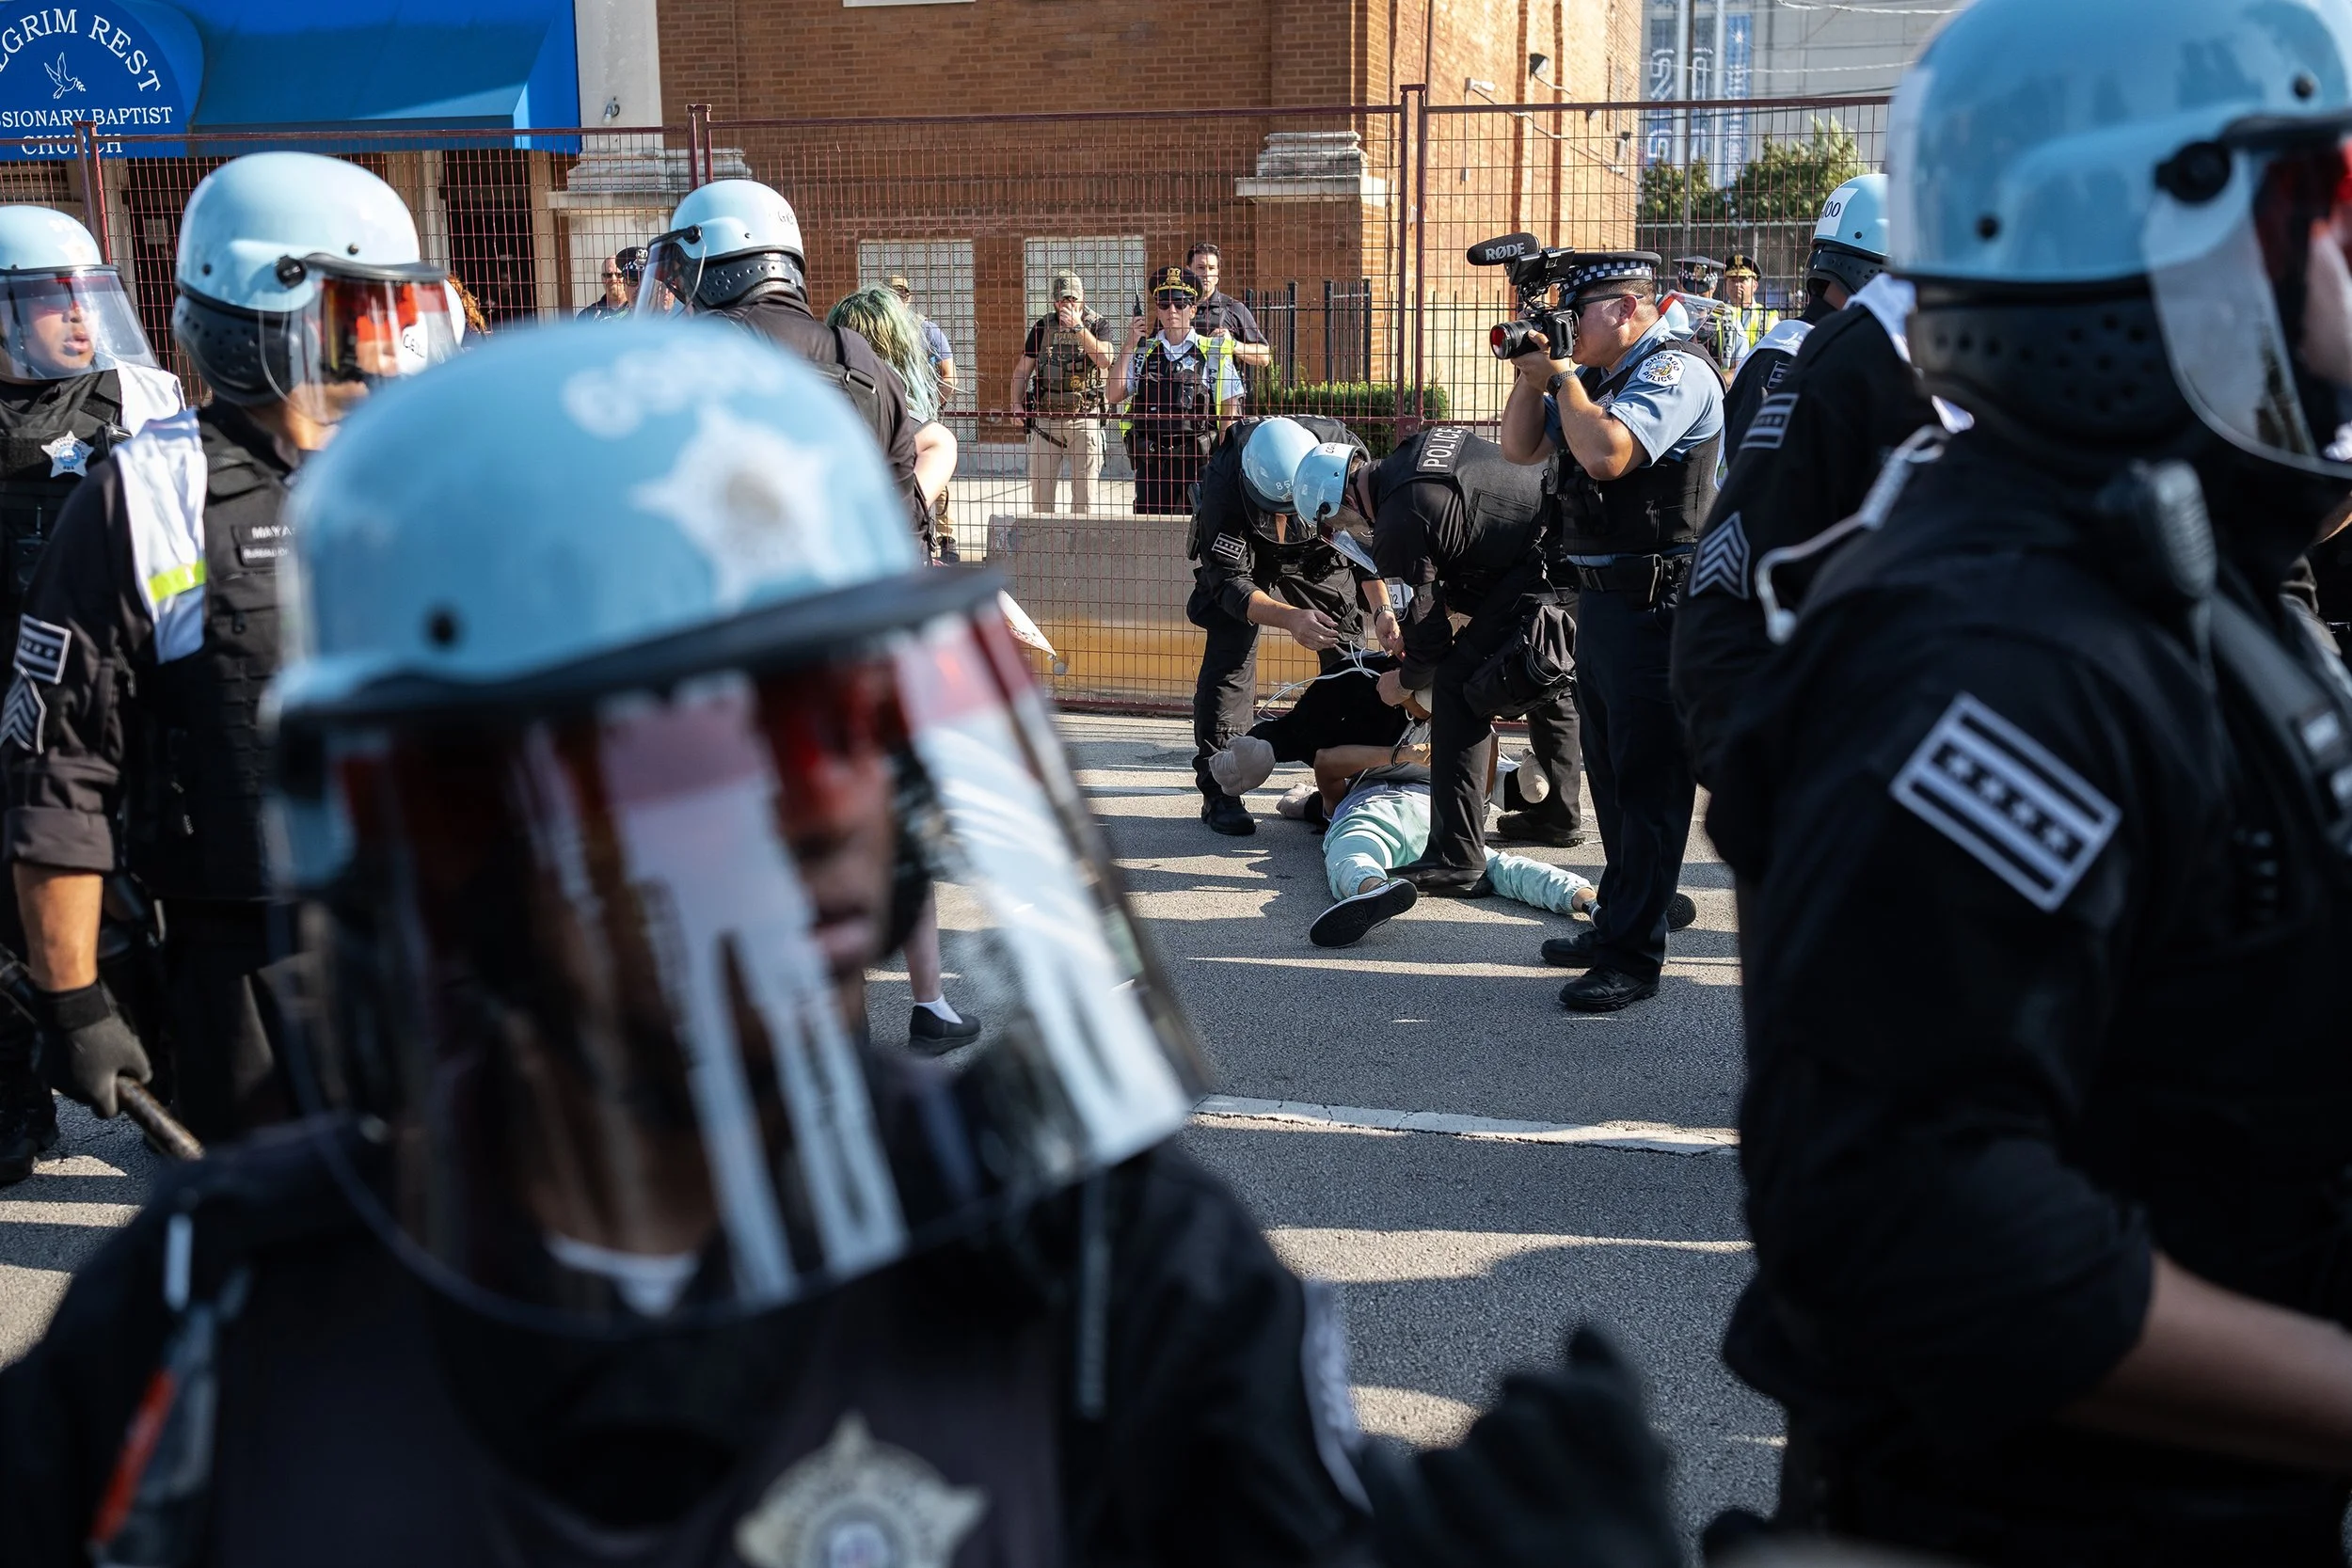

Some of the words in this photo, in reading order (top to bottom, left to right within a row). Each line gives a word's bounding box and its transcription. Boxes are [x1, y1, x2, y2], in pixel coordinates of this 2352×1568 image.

[88, 14, 162, 92] REST
[0, 109, 86, 128] SIONARY
[91, 106, 173, 125] BAPTIST
[1485, 242, 1526, 261] RØDE
[1645, 355, 1680, 372] CHICAGO
[1642, 371, 1674, 383] POLICE
[1422, 427, 1463, 468] POLICE
[251, 525, 294, 539] MAYA
